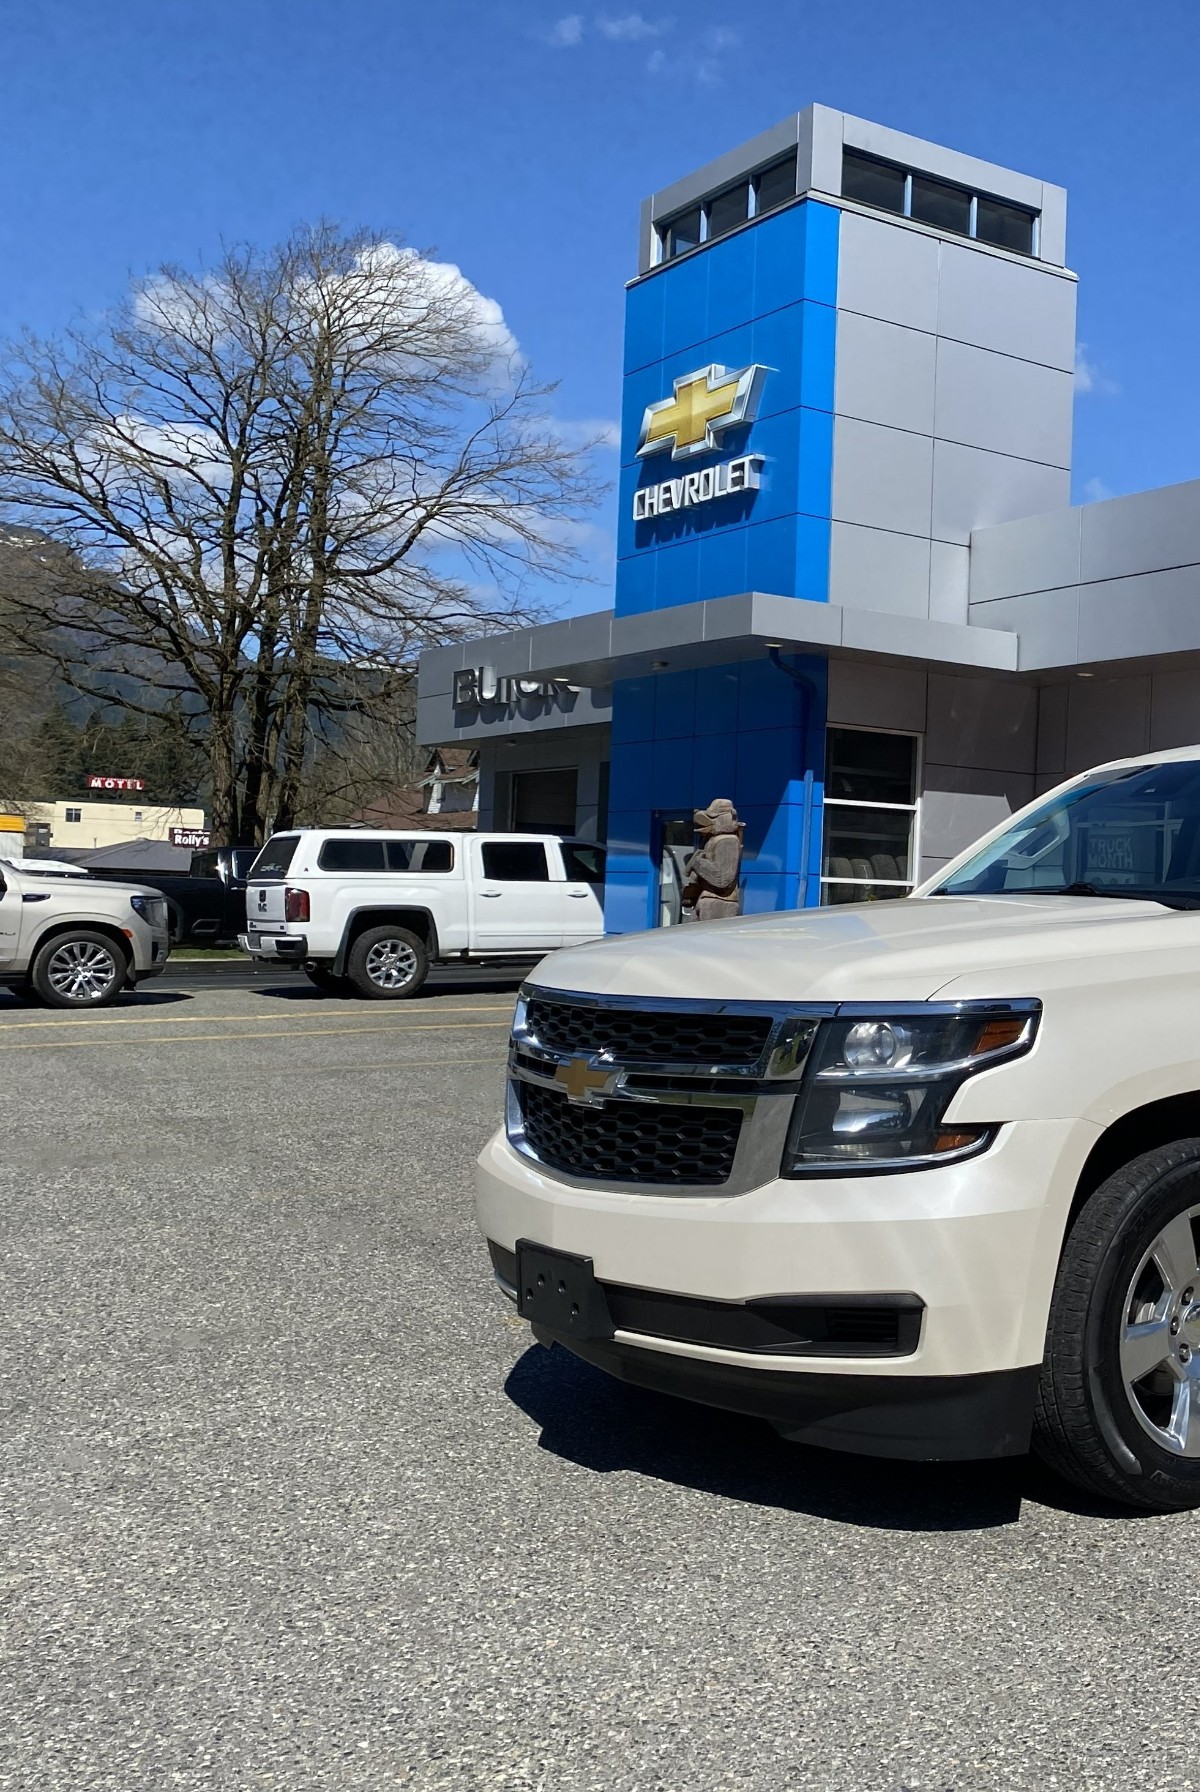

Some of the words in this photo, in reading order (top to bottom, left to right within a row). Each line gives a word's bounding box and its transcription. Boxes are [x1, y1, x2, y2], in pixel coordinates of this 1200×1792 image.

[633, 453, 765, 521] CHEVROLET
[91, 779, 143, 790] MOTEL
[174, 834, 210, 847] Rolly's
[1089, 837, 1131, 852] TRUCK
[1088, 852, 1133, 868] MONTH
